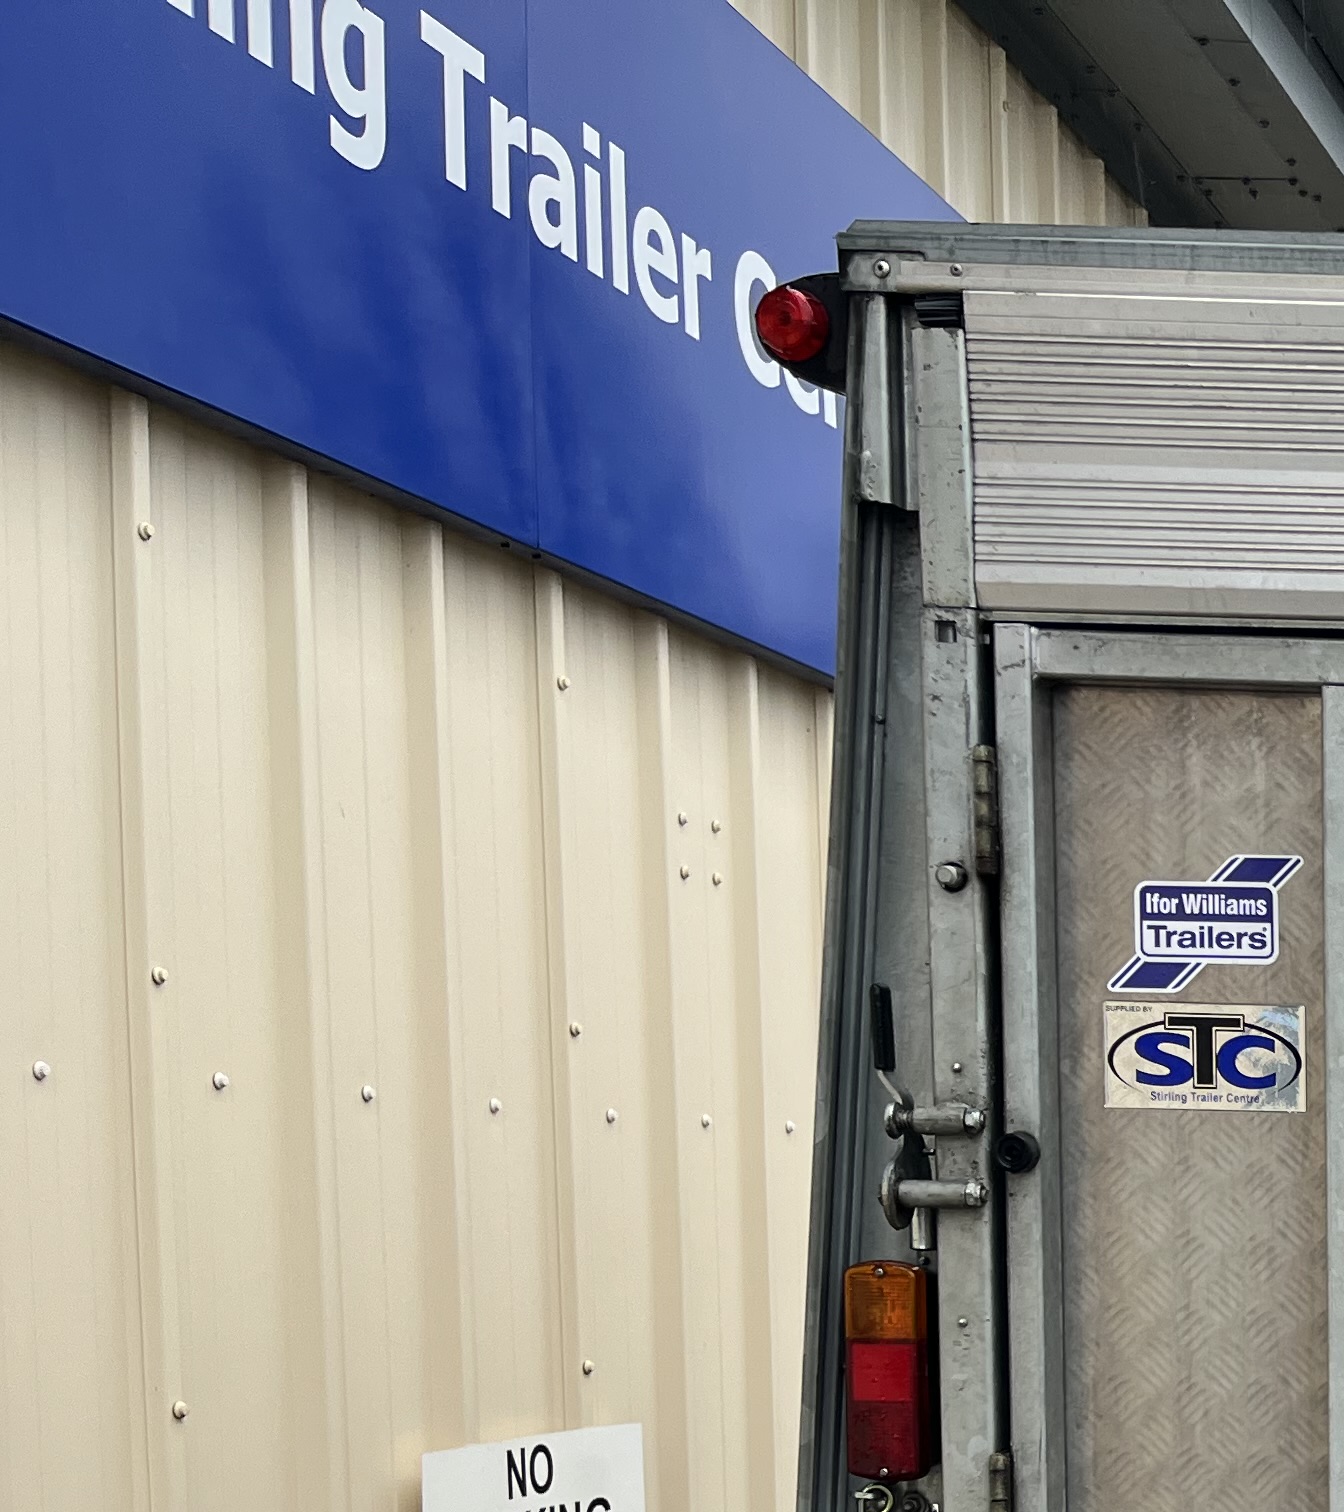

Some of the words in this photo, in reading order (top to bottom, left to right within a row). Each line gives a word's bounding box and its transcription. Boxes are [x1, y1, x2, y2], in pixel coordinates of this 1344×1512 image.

[420, 8, 712, 341] Trailer
[1145, 892, 1179, 914] Ifor
[1182, 893, 1268, 916] Williams
[1134, 1012, 1277, 1090] STC
[1150, 1090, 1188, 1104] Stirling
[1191, 1091, 1224, 1103] Trailer
[1226, 1092, 1260, 1104] Centre
[506, 1444, 554, 1499] NO
